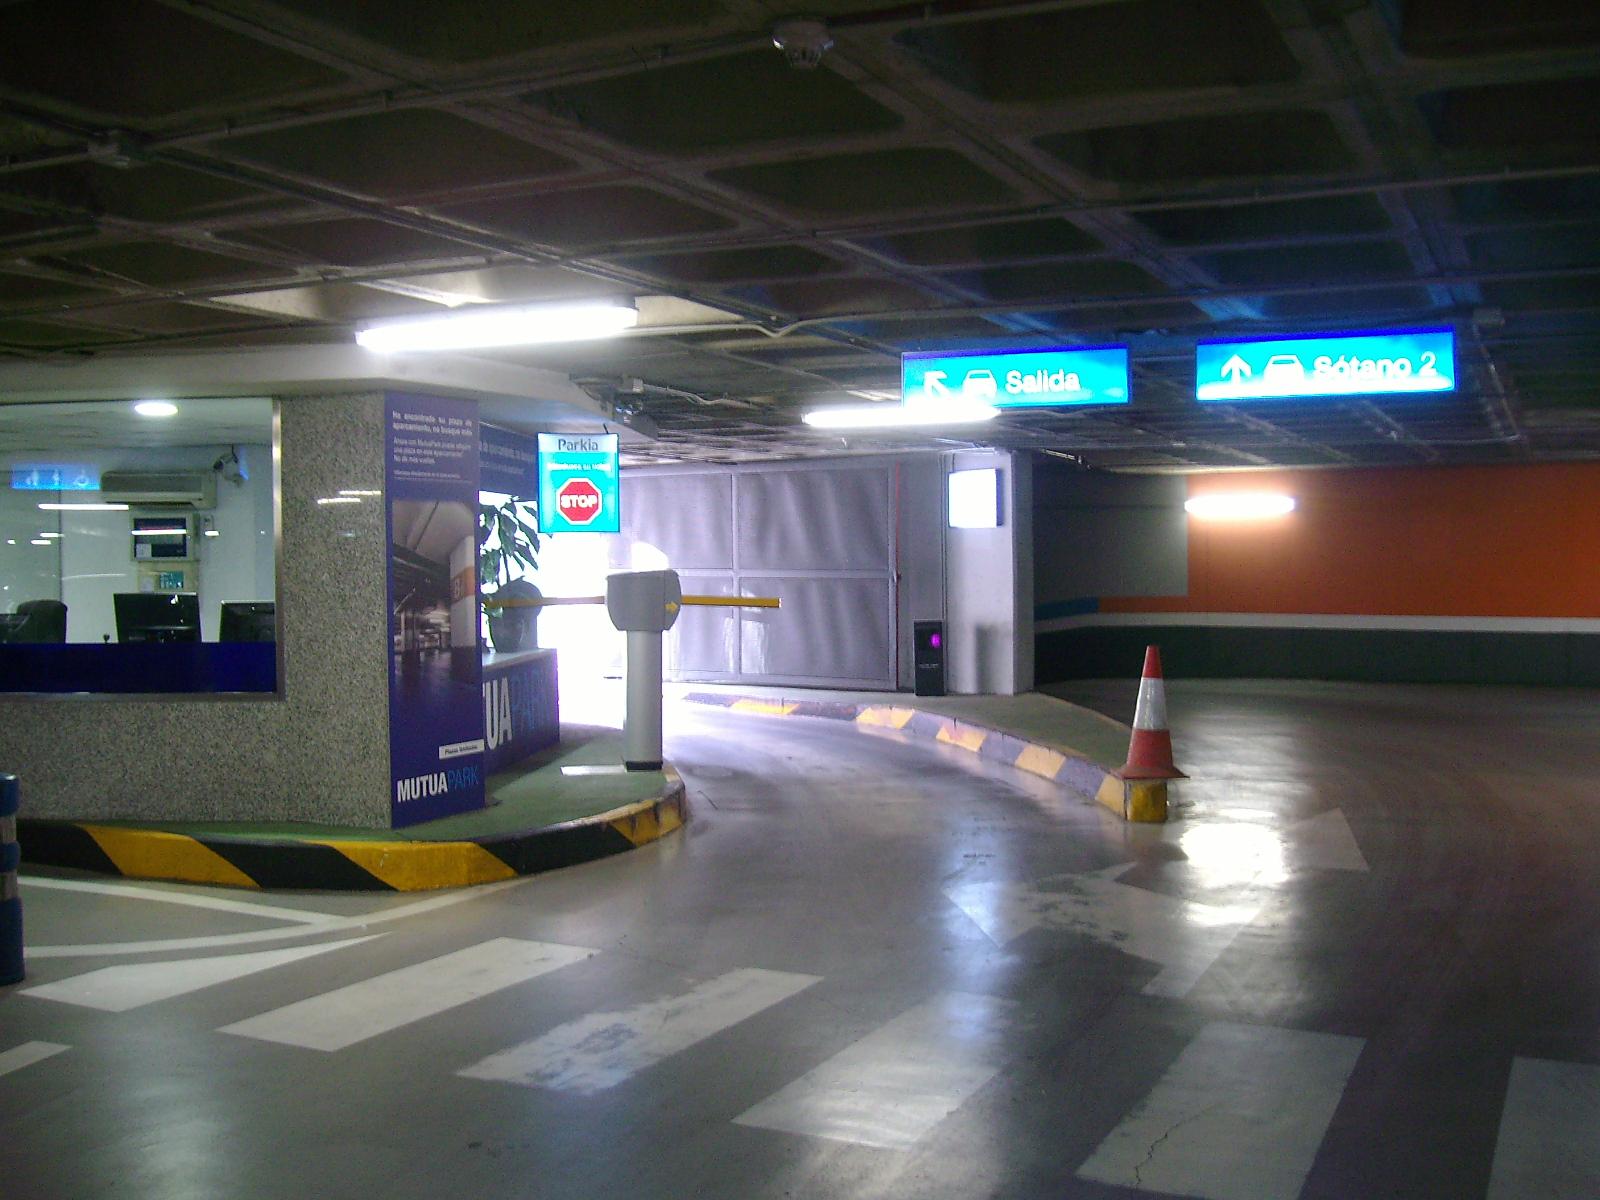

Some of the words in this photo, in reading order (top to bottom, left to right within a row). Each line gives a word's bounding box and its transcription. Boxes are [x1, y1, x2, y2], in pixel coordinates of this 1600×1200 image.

[1313, 354, 1413, 380] Sótano
[1420, 351, 1438, 377] 2
[1005, 369, 1080, 394] Salida
[558, 438, 599, 451] Parkia
[560, 494, 598, 509] STOP
